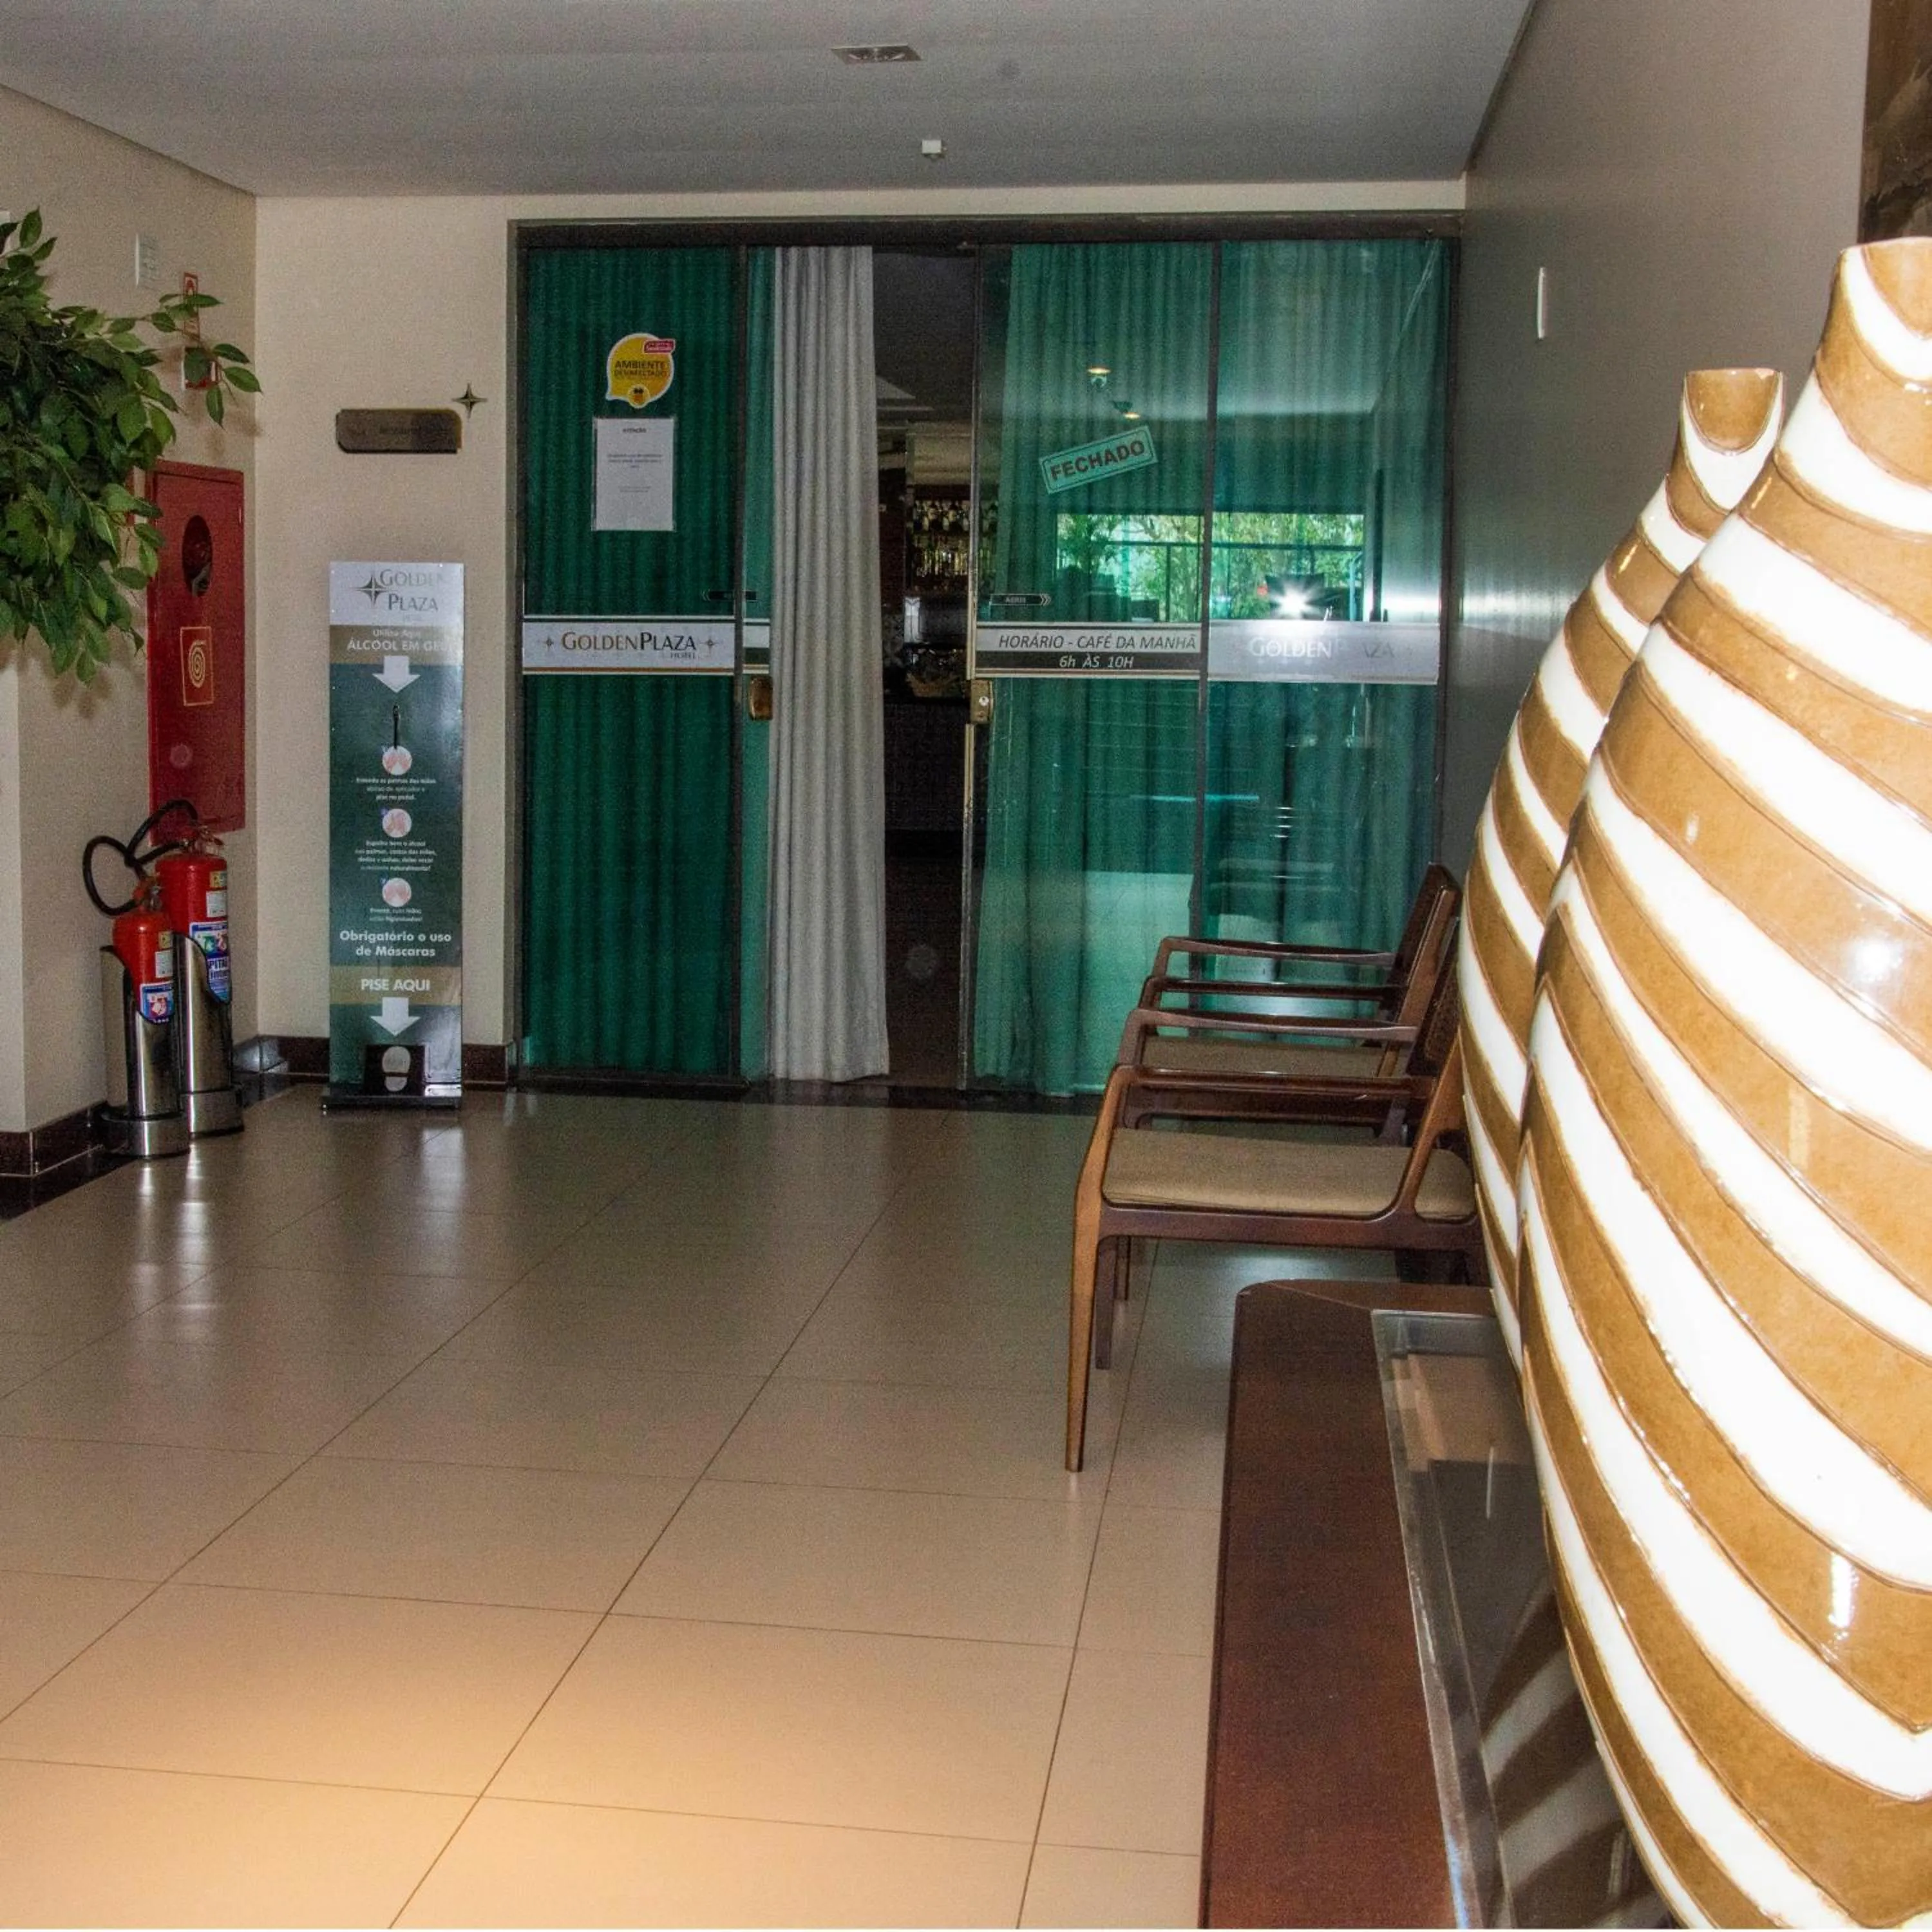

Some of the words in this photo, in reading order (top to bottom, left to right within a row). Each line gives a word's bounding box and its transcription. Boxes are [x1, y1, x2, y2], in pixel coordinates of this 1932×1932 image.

[614, 360, 666, 370] AMBIENTE
[1050, 440, 1145, 480] FECHADO
[388, 593, 439, 611] PLAZA
[402, 640, 419, 651] EM
[998, 632, 1064, 649] HORÁRIO
[1077, 632, 1112, 649] CAFÉ
[1115, 636, 1136, 649] DA
[1139, 634, 1197, 650] MANHÃ
[1059, 655, 1076, 668] 6h
[1082, 654, 1101, 668] ÀS
[1106, 656, 1134, 668] 10H
[339, 929, 414, 944] Obrigatório
[430, 934, 452, 943] uso
[355, 946, 372, 956] de
[376, 945, 436, 958] Máscaras
[361, 978, 390, 991] PISE
[393, 978, 431, 992] AQUI
